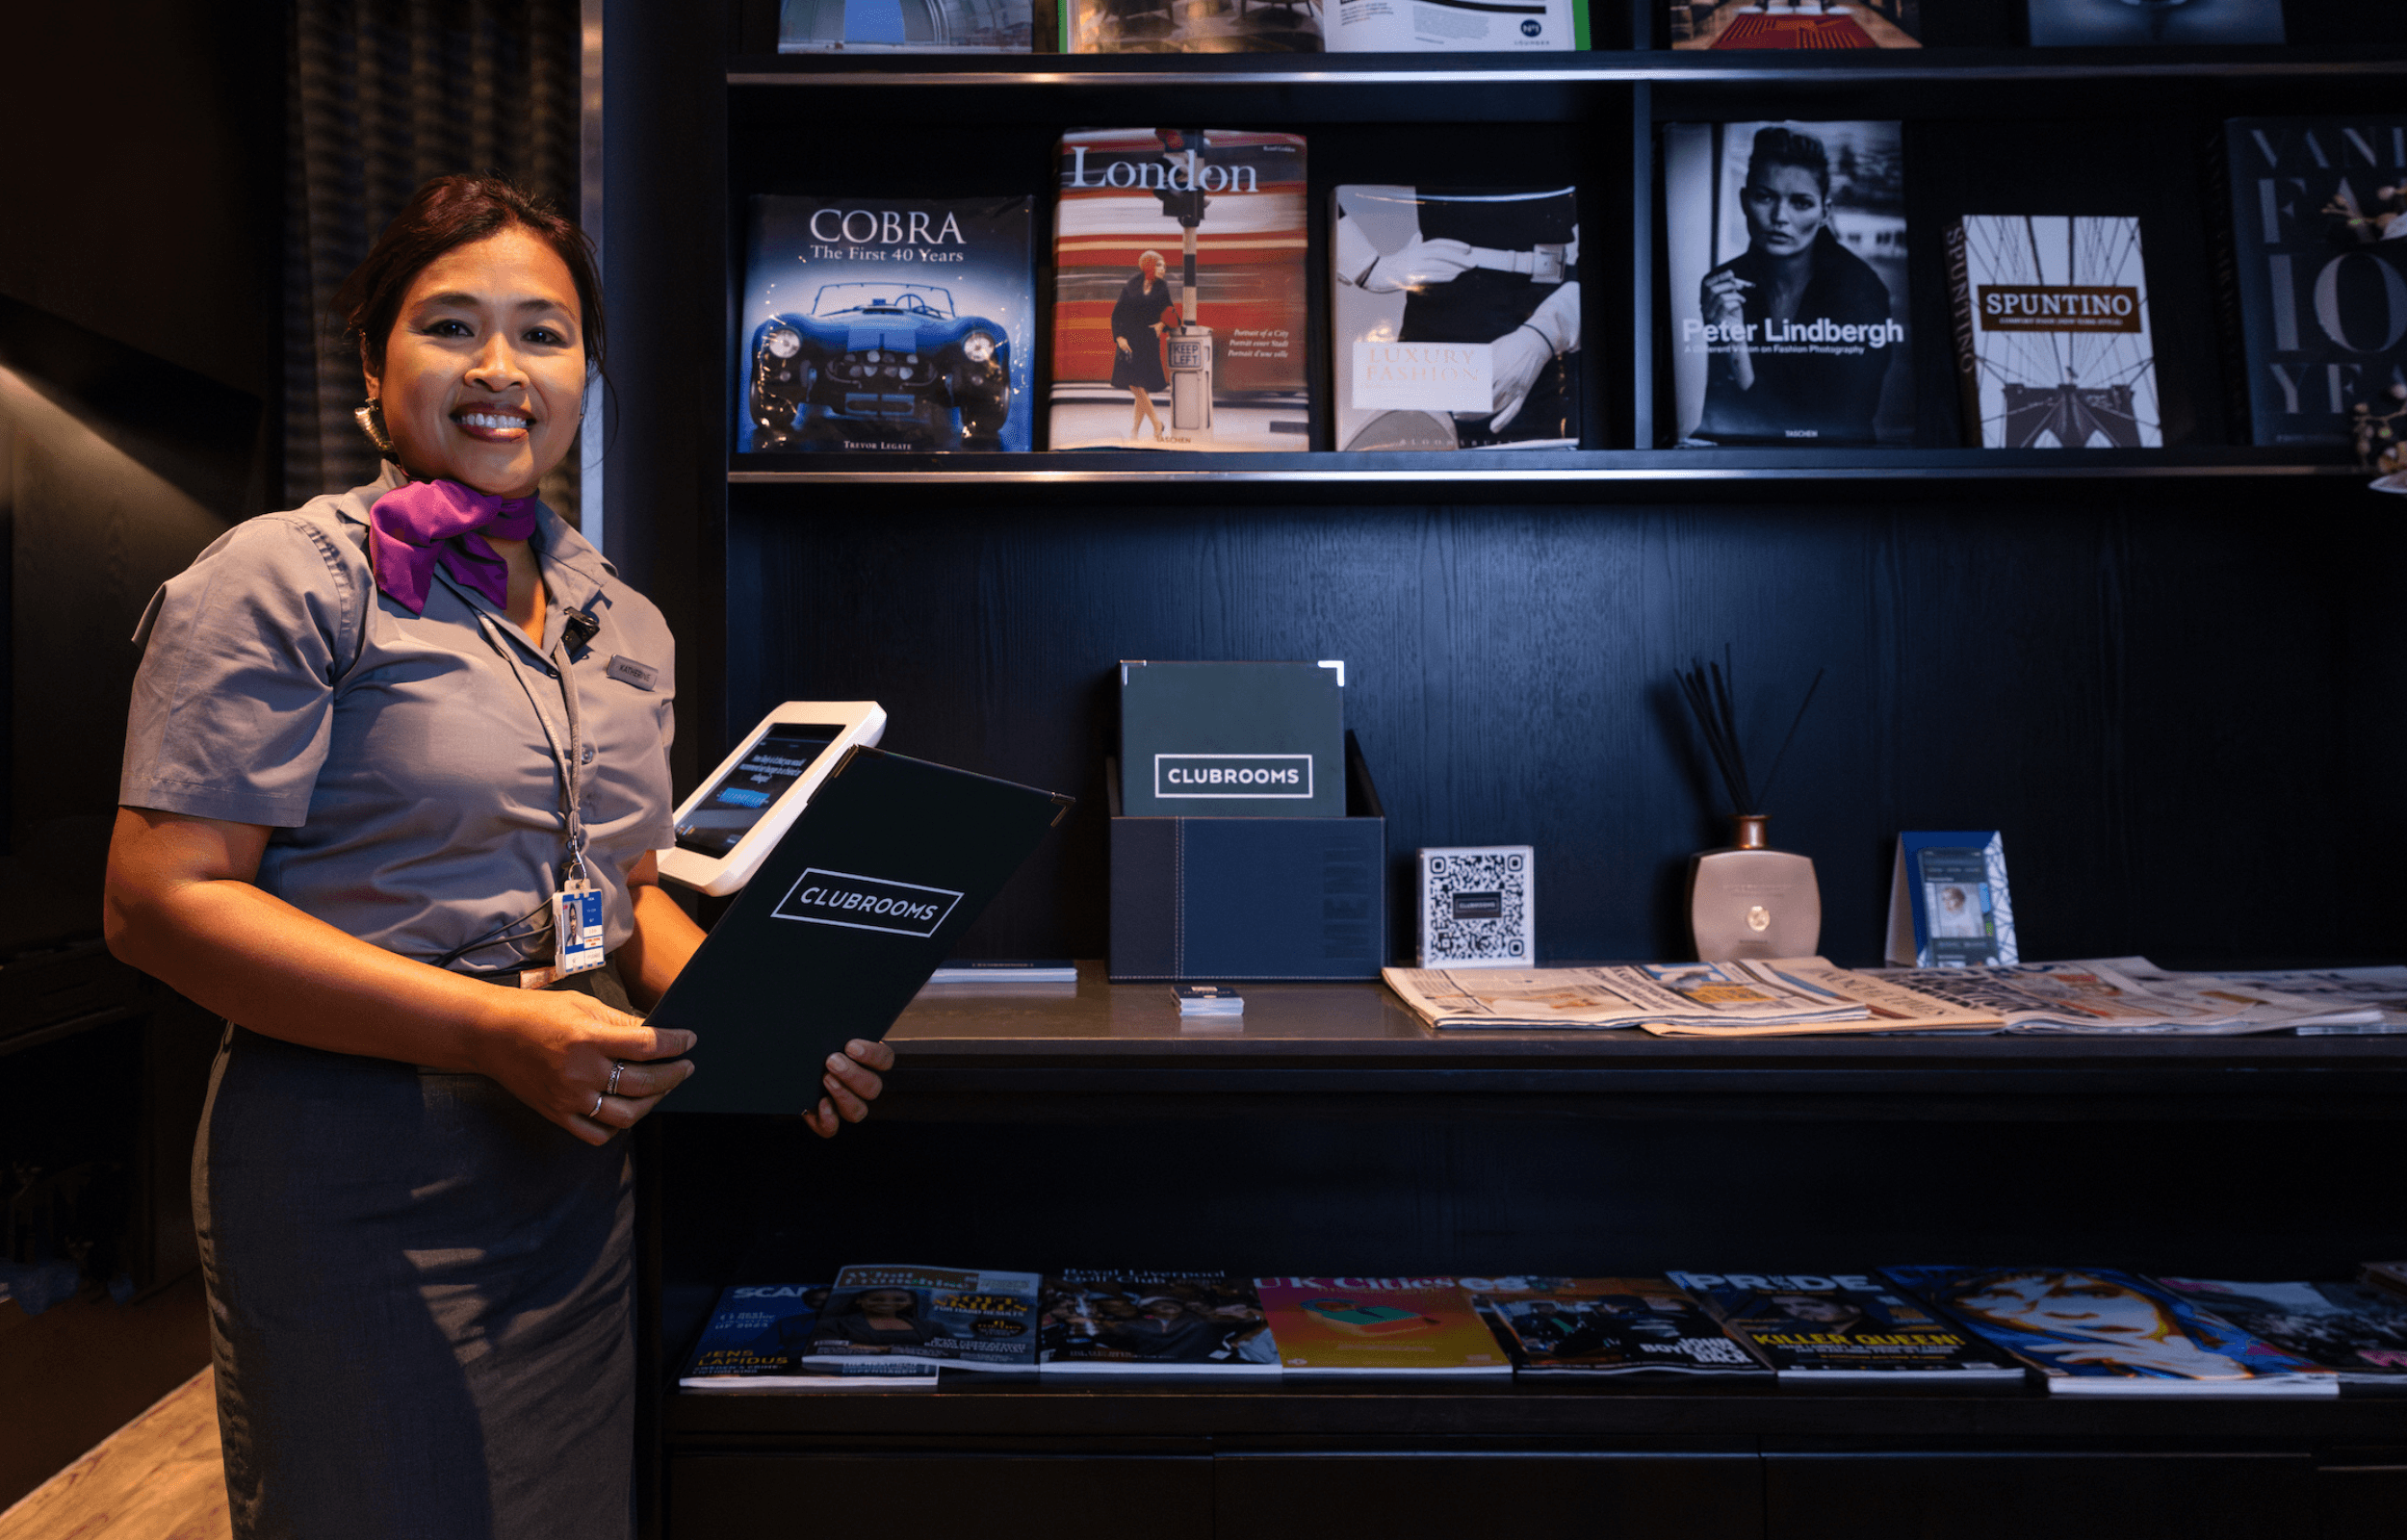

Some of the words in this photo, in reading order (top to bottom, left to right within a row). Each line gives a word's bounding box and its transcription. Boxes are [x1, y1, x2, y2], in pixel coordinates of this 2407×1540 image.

[1069, 146, 1259, 192] London
[810, 208, 967, 244] COBRA
[811, 244, 843, 260] The
[849, 246, 887, 261] First
[892, 248, 914, 262] 40
[919, 248, 964, 262] Years
[1985, 293, 2133, 317] SPUNTINO
[1682, 318, 1758, 344] Peter
[1764, 318, 1903, 348] Lindbergh
[1174, 345, 1199, 354] KEEP
[1370, 347, 1475, 365] LUXURY
[1174, 355, 1198, 365] LEFT
[1367, 367, 1479, 382] FASHION
[843, 440, 877, 449] TREVOR
[881, 441, 912, 450] LEGATE
[1168, 768, 1300, 784] CLUBROOMS
[800, 886, 939, 921] CLUBROOMS
[1684, 1273, 1885, 1292] PRIDE
[1751, 1333, 1852, 1346] KILLER
[1854, 1333, 1966, 1346] QUEEN!
[697, 1357, 789, 1366] LAPIDUS
[700, 1349, 754, 1358] JENS
